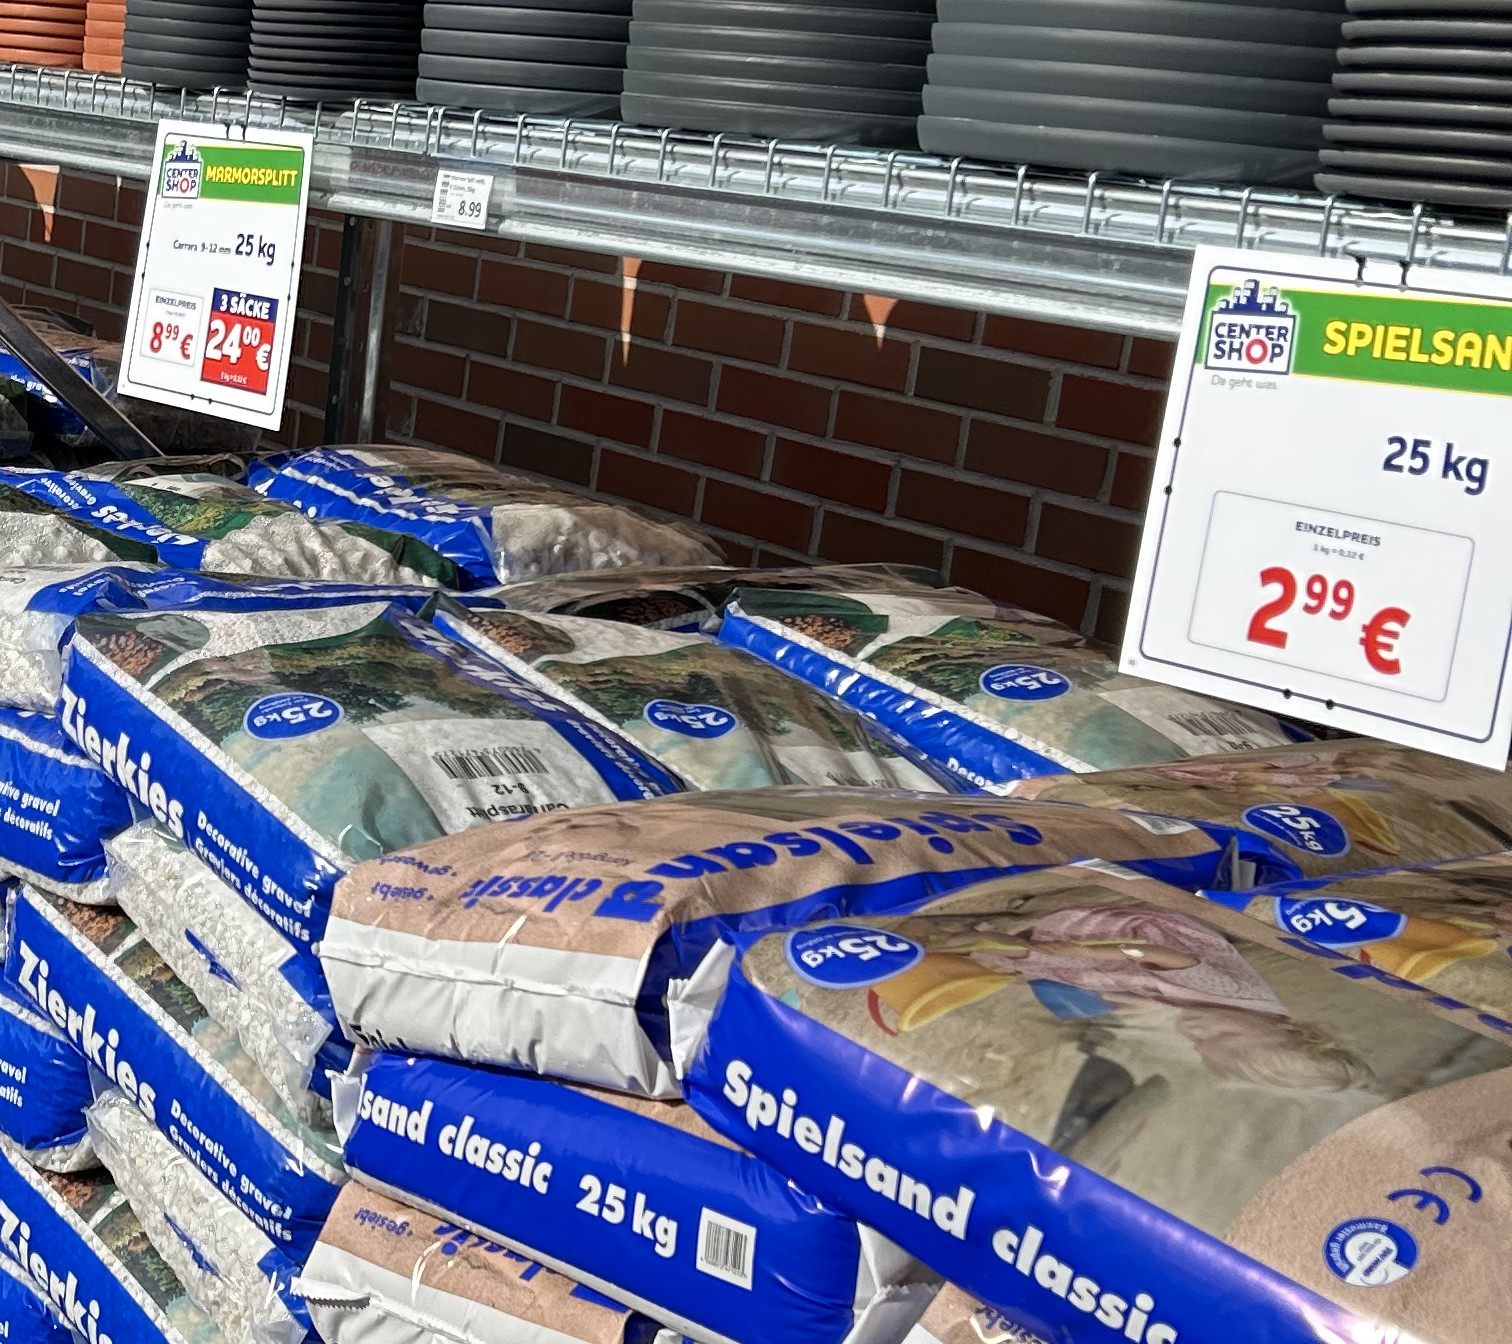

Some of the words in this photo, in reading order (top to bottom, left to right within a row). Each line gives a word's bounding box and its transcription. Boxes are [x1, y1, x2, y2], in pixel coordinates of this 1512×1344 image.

[165, 177, 197, 195] SHOP
[166, 167, 198, 181] CENTER
[205, 165, 298, 189] MARMORSPLITT
[458, 200, 482, 218] 8.99
[173, 239, 198, 253] Carrara
[235, 233, 254, 257] 25
[258, 235, 276, 266] kg
[219, 294, 227, 312] 3
[230, 291, 271, 320] SÄCKE
[1215, 322, 1289, 342] CENTER
[180, 334, 194, 360] €
[256, 343, 272, 371] €
[1213, 339, 1285, 364] SHOP
[1211, 374, 1226, 386] Da
[1229, 377, 1253, 390] geht
[1382, 435, 1430, 475] 25
[1441, 442, 1489, 496] kg
[1295, 521, 1381, 547] EINZELPREIS
[1358, 607, 1411, 676] €
[21, 790, 62, 818] gravel
[59, 682, 185, 841] Zierkies
[196, 810, 260, 882] Decorative
[261, 872, 313, 920] gravel
[3, 809, 55, 841] décoratifs
[243, 880, 312, 944] décoratifs
[18, 938, 159, 1123] Zierkies
[170, 1098, 238, 1178] Decorative
[239, 1170, 294, 1220] gravel
[721, 1058, 975, 1242] Spielsand
[168, 1124, 219, 1188] Graviers
[220, 1178, 293, 1243] décoratifs
[437, 1115, 551, 1196] classic
[576, 1173, 627, 1226] 25
[632, 1191, 679, 1258] kg
